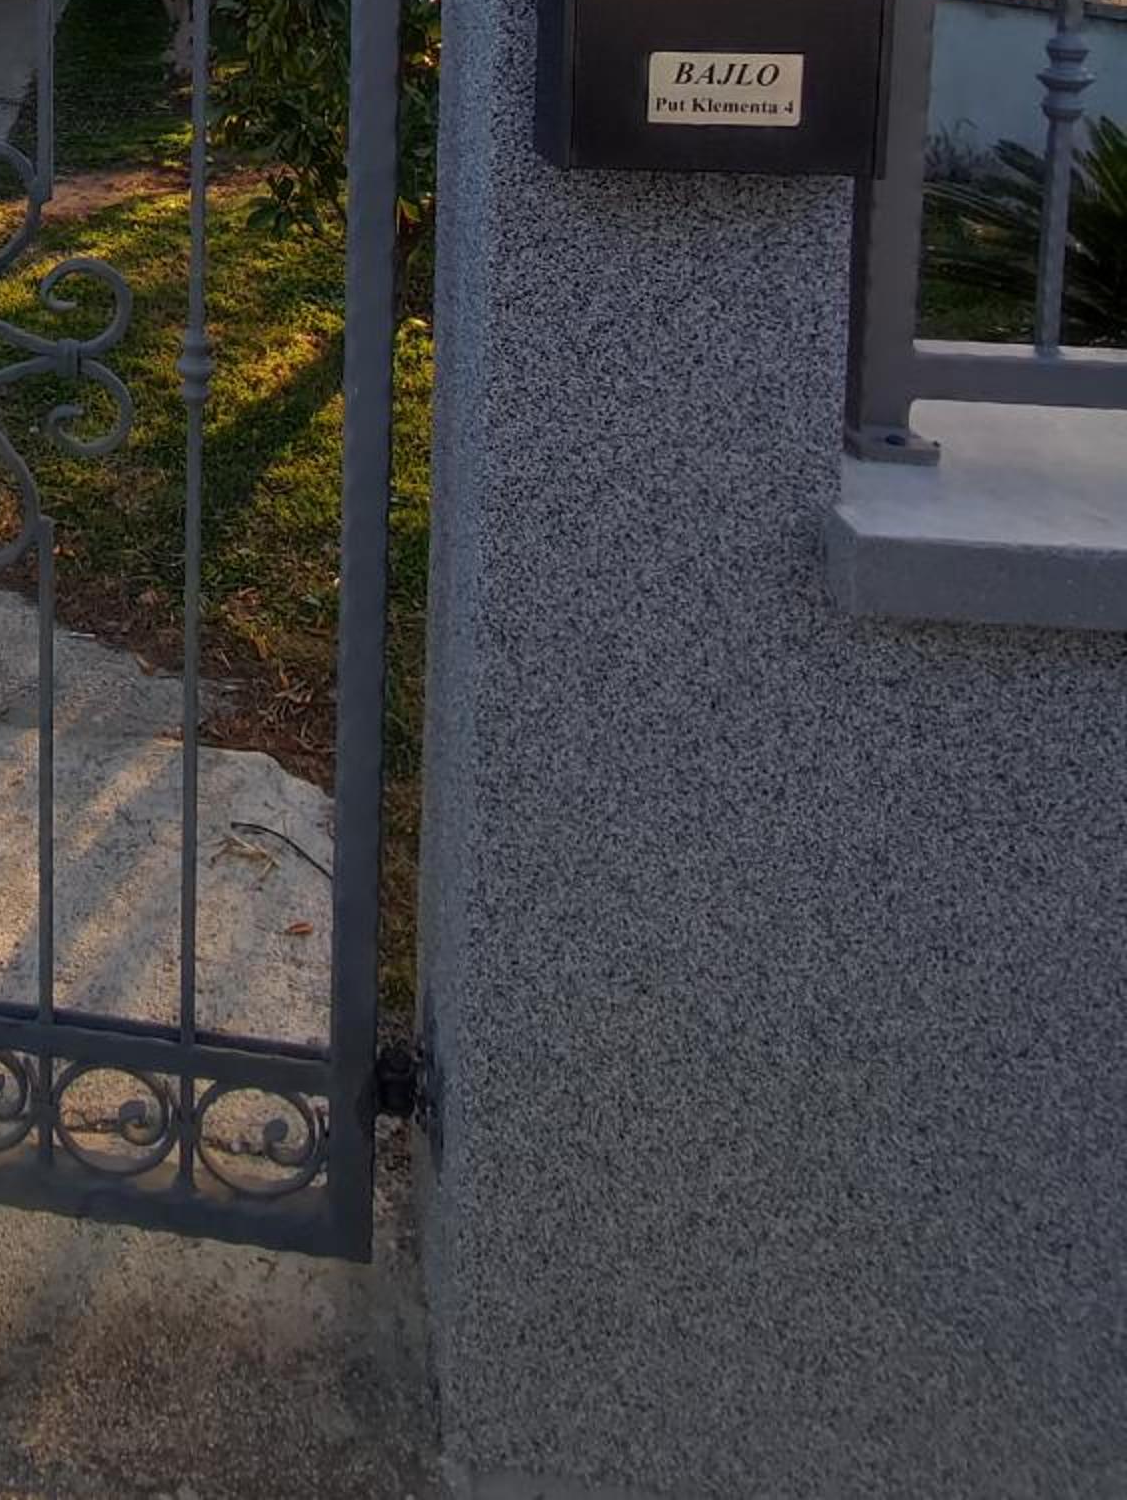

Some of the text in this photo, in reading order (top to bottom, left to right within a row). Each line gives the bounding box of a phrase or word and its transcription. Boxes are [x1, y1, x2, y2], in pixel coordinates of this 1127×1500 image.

[674, 61, 781, 87] BAJLO
[656, 97, 794, 114] Put Klementa 4
